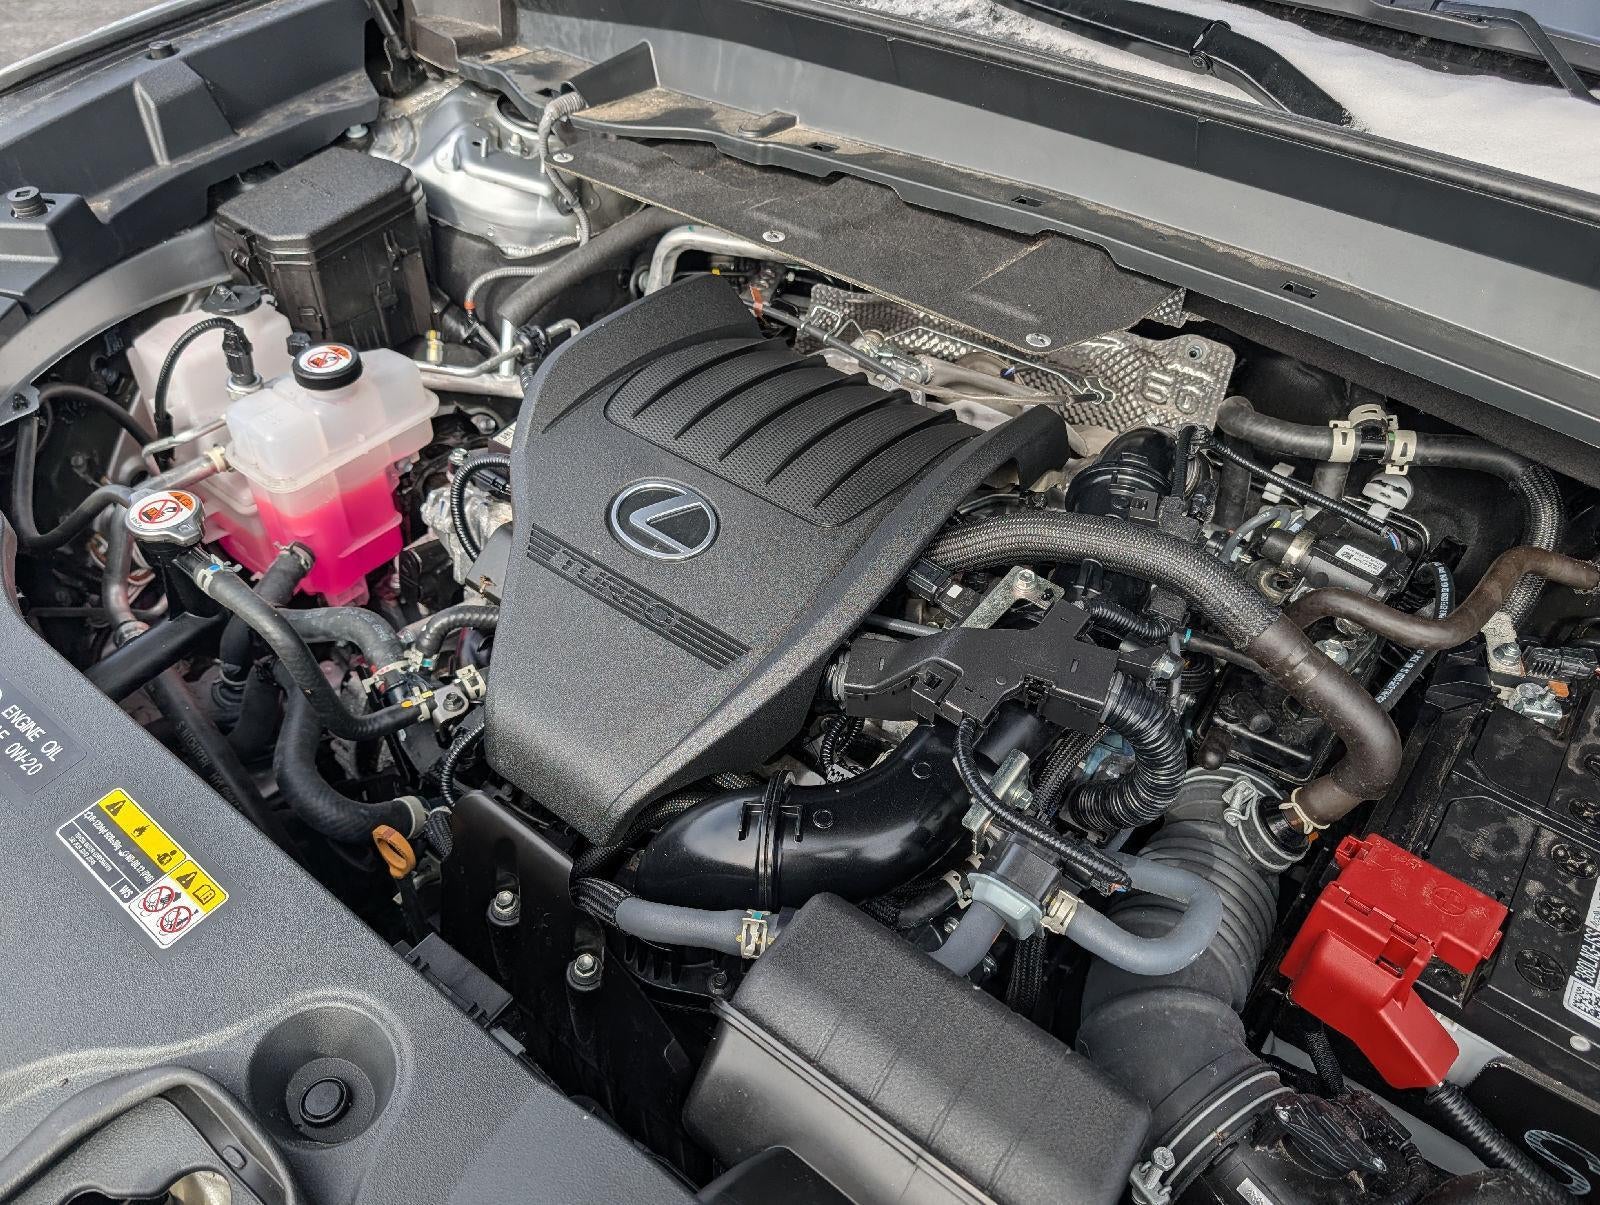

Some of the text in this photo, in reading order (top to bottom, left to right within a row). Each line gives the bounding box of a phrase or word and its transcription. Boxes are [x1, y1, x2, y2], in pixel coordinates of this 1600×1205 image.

[560, 548, 676, 627] TURBO
[1, 704, 63, 761] ENGINE OIL
[5, 742, 43, 775] 0W-20
[119, 884, 133, 898] WS
